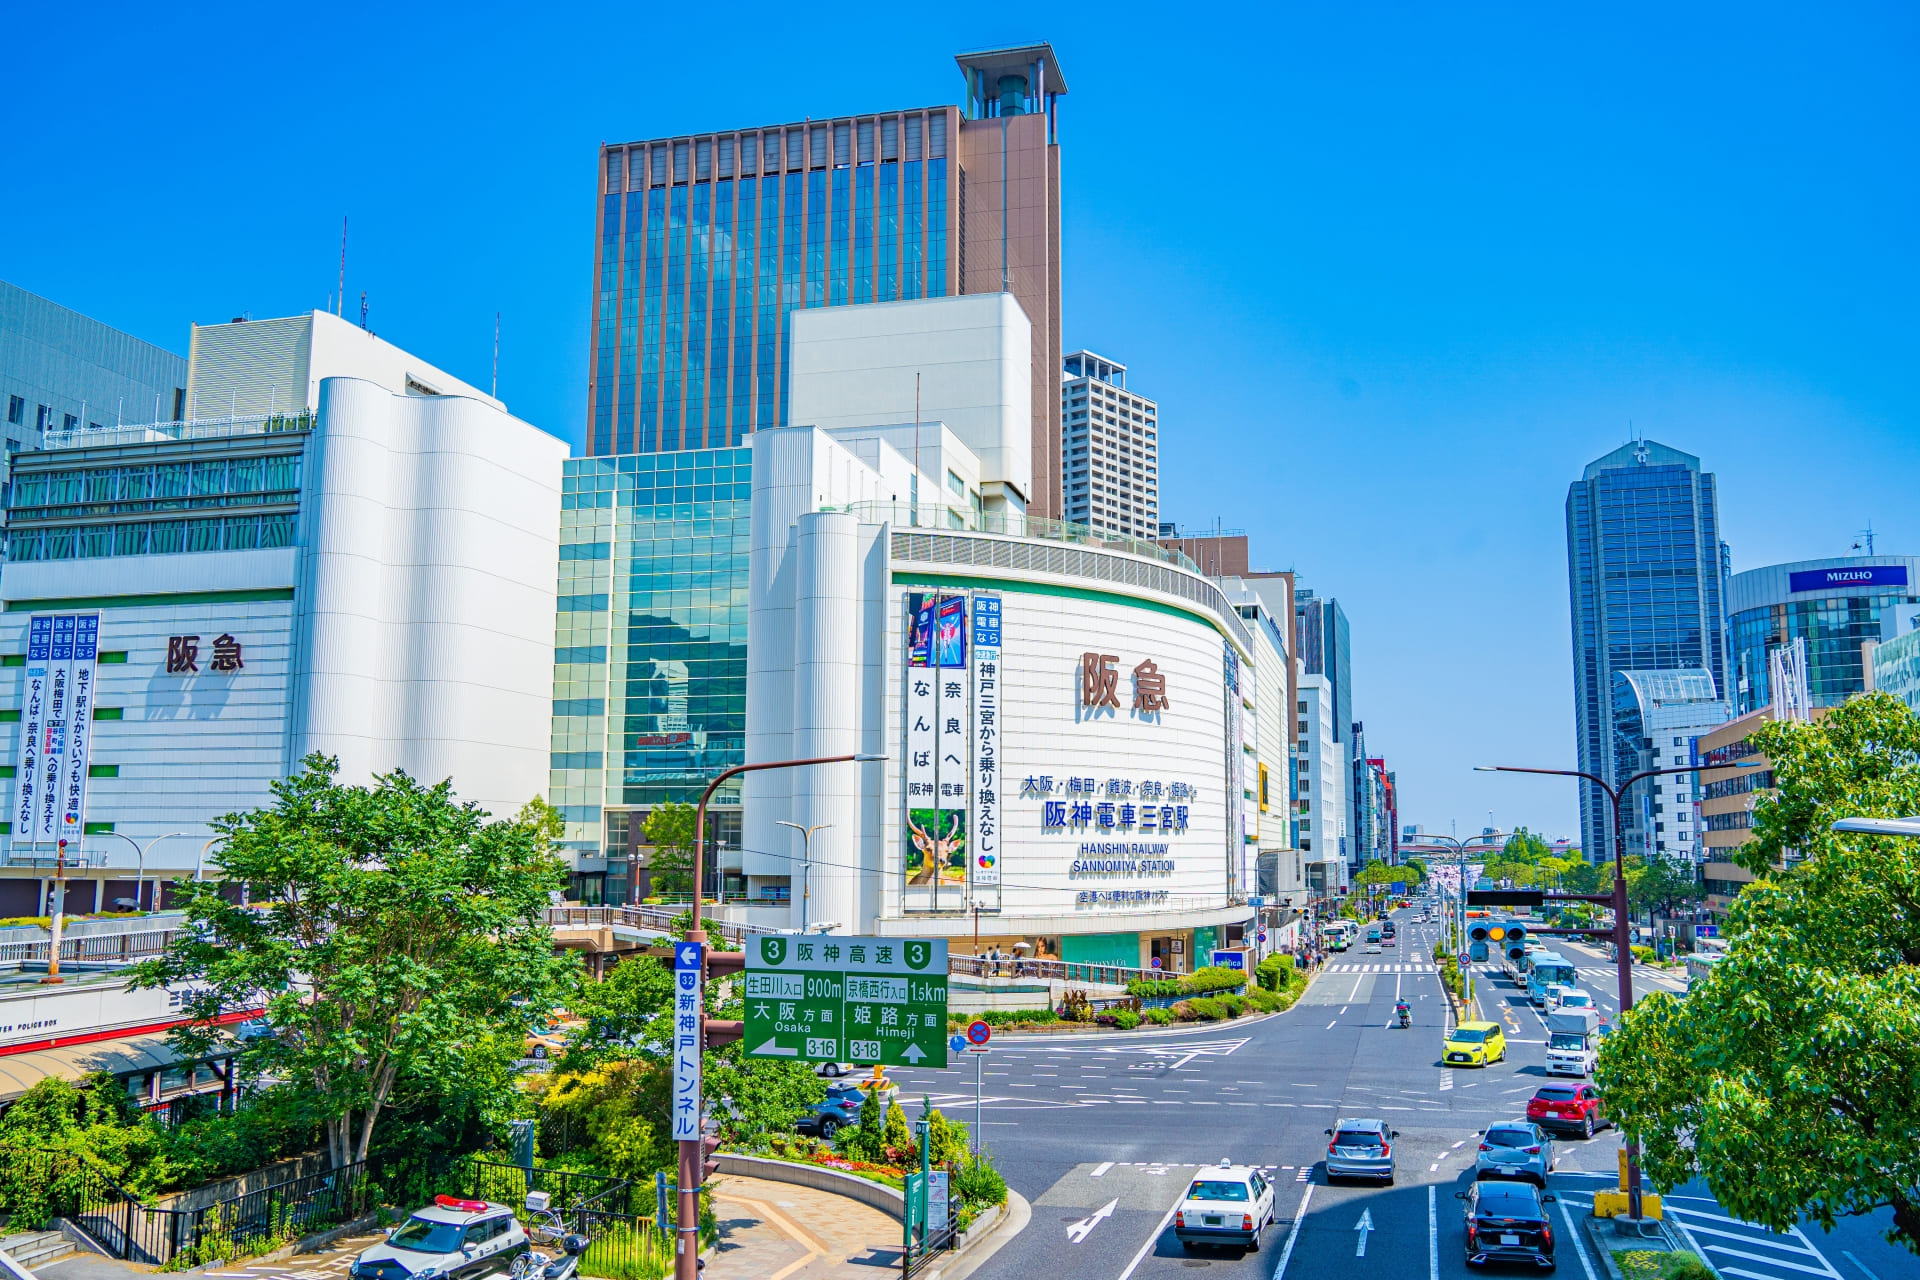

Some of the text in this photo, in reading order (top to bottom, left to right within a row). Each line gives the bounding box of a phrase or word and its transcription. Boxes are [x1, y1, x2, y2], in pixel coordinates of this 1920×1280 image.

[1827, 571, 1873, 582] MIZUHO
[976, 600, 999, 613] 阪神
[32, 620, 51, 630] 阪神
[55, 619, 74, 630] 阪神
[78, 619, 97, 629] 阪神
[976, 616, 999, 628] 電車
[976, 631, 999, 644] なら
[30, 648, 48, 658] なら
[53, 647, 71, 658] なら
[76, 647, 94, 658] なら
[166, 633, 244, 674] 阪急
[1083, 651, 1170, 711] 阪急
[913, 680, 930, 768] なんば
[944, 681, 962, 766] 奈良へ
[978, 662, 996, 852] 神戸三宮から乗り換えなし
[908, 782, 934, 797] 阪神
[940, 782, 965, 797] 電車
[1045, 801, 1189, 829] 阪神電車三宮駅
[1081, 843, 1169, 855] HANSHIN RAILWAY
[1073, 860, 1175, 872] SANNOMIYA STATION
[767, 940, 924, 965] 3 阪神高速 3
[681, 975, 694, 985] 32
[747, 976, 842, 998] 生田川入口 900m
[848, 980, 946, 1002] 京橋西行入口 1.5km
[17, 1021, 42, 1031] POLICE
[774, 1021, 811, 1033] Osaka
[876, 1026, 915, 1040] Himeji
[807, 1039, 834, 1056] 3-16
[851, 1041, 879, 1058] 3-18
[676, 993, 696, 1135] 新神戸トンネル
